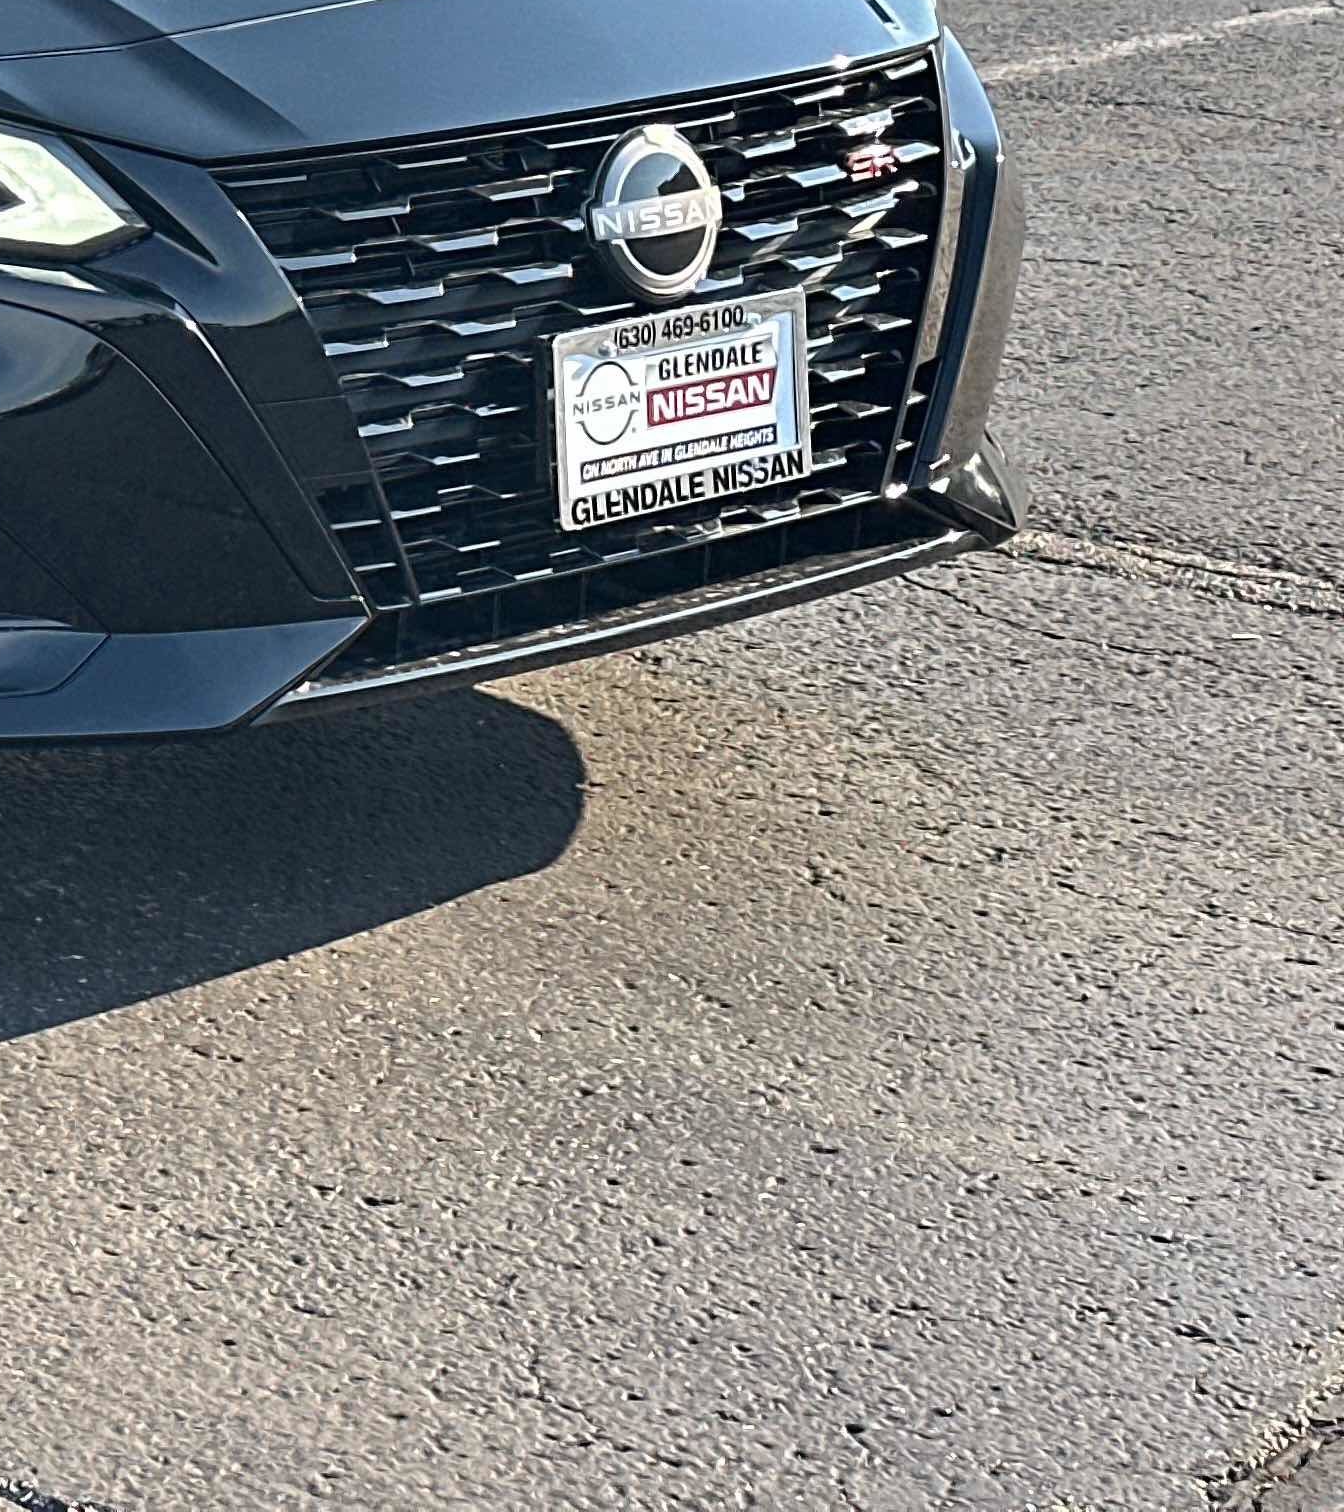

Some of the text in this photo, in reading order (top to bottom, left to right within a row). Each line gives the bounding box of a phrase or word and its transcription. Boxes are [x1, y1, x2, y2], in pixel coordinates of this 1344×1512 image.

[596, 194, 719, 236] NISSAN
[614, 304, 745, 350] (630) 469-6100
[658, 341, 763, 381] GLENDALE
[573, 391, 641, 416] NISSAN
[651, 372, 772, 423] NISSAN
[599, 456, 637, 476] NORTH
[674, 436, 729, 462] GLENDALE
[729, 427, 775, 449] HEIGHTS
[570, 451, 805, 526] GLENDALE NISSAN
